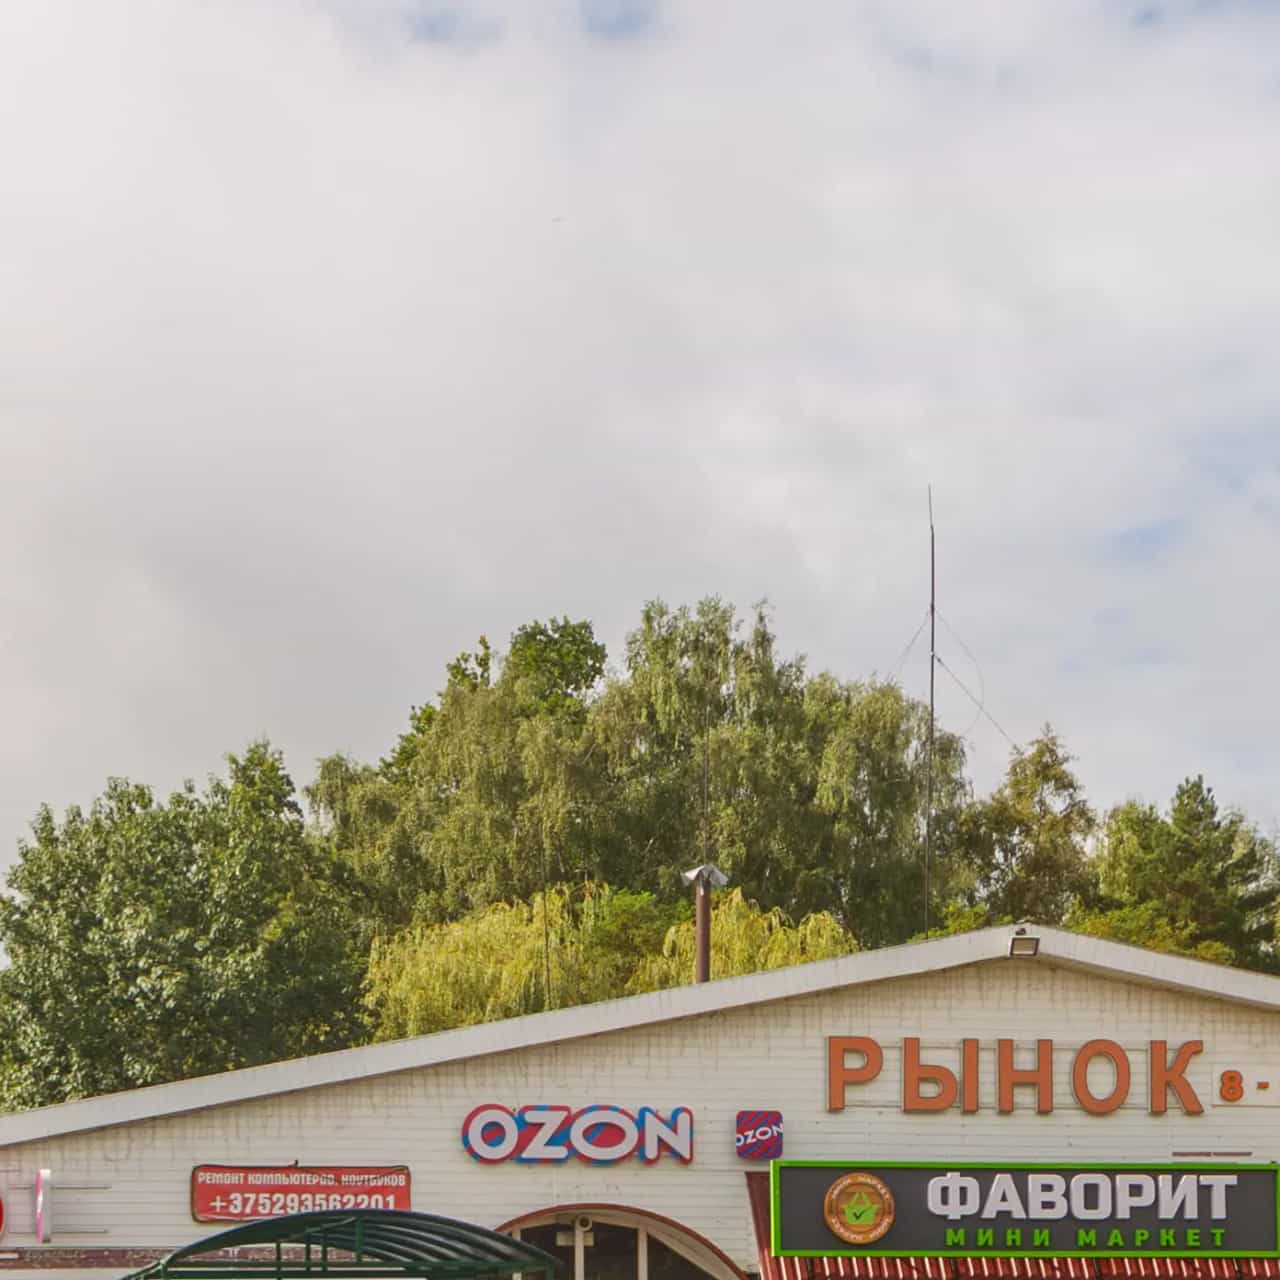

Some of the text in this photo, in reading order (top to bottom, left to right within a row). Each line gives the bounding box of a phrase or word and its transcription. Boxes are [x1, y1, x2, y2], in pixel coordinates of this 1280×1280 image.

[827, 1036, 1204, 1114] РЫНОК
[1219, 1070, 1243, 1102] 8
[463, 1105, 693, 1164] OZON
[736, 1123, 783, 1147] OZON
[927, 1172, 1238, 1220] ФАВОРИТ
[945, 1228, 1225, 1248] МИНИ МАРКЕТ
